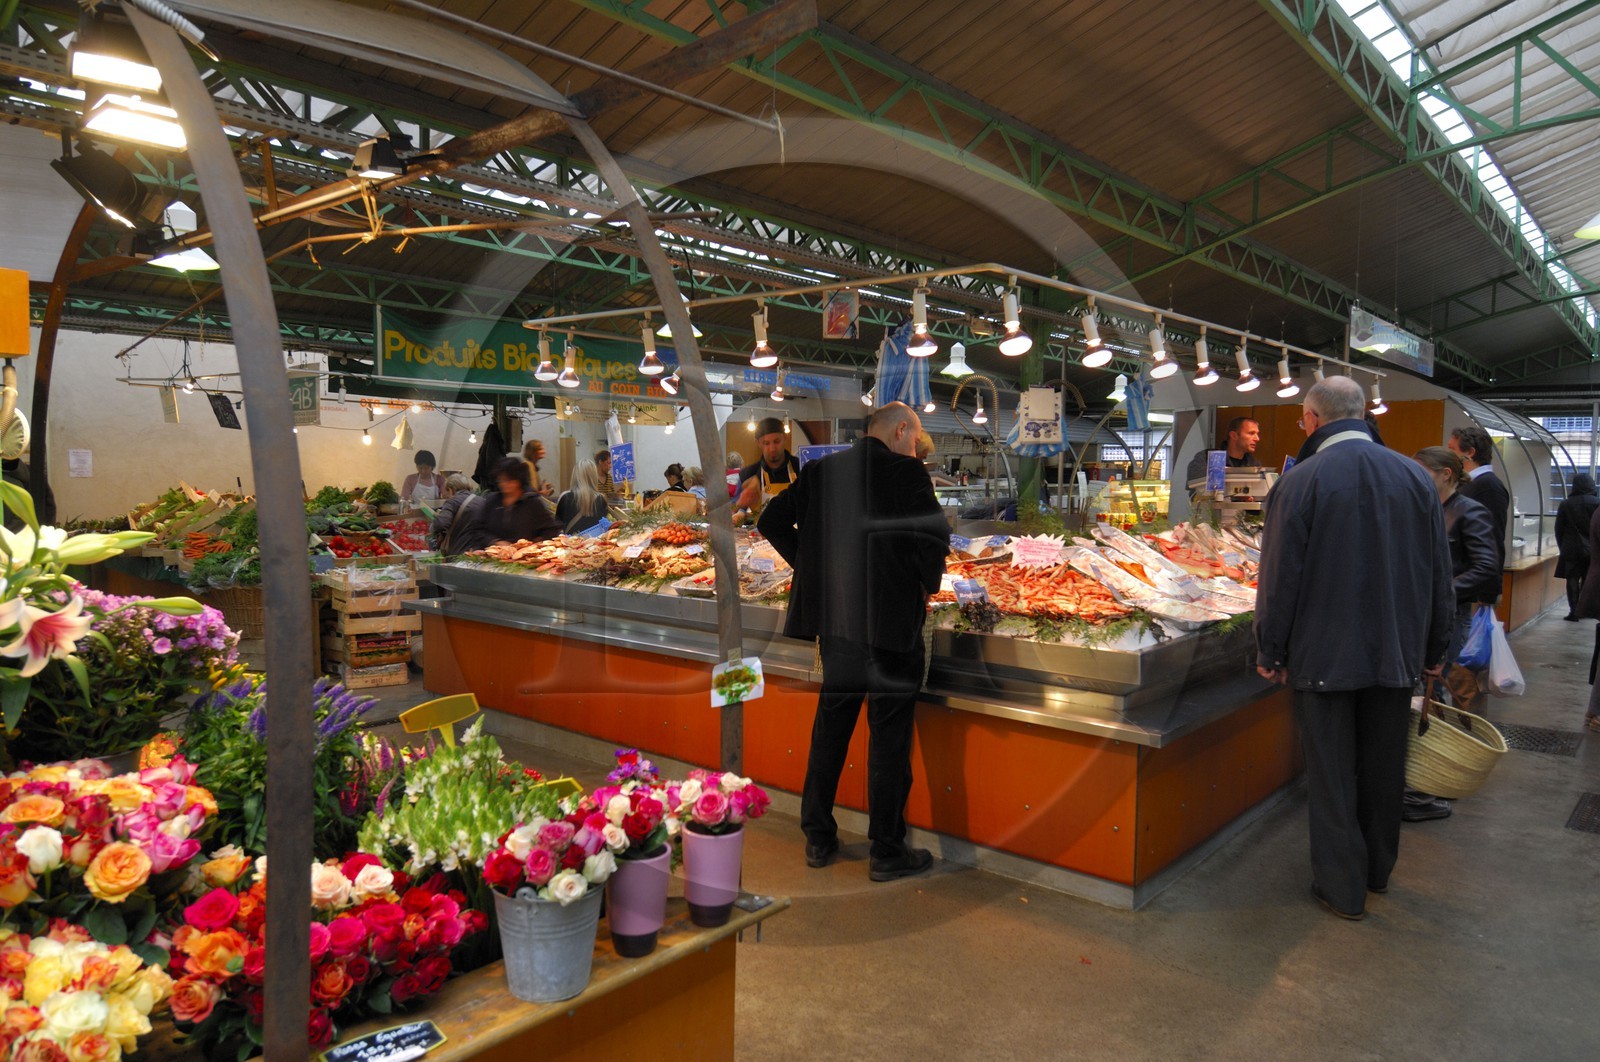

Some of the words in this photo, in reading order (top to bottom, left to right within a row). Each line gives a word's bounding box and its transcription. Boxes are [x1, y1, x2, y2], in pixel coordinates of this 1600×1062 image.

[385, 329, 497, 370] Produits
[291, 387, 313, 410] AB
[588, 381, 604, 394] AU
[610, 381, 640, 396] COIN
[647, 386, 668, 398] BIO
